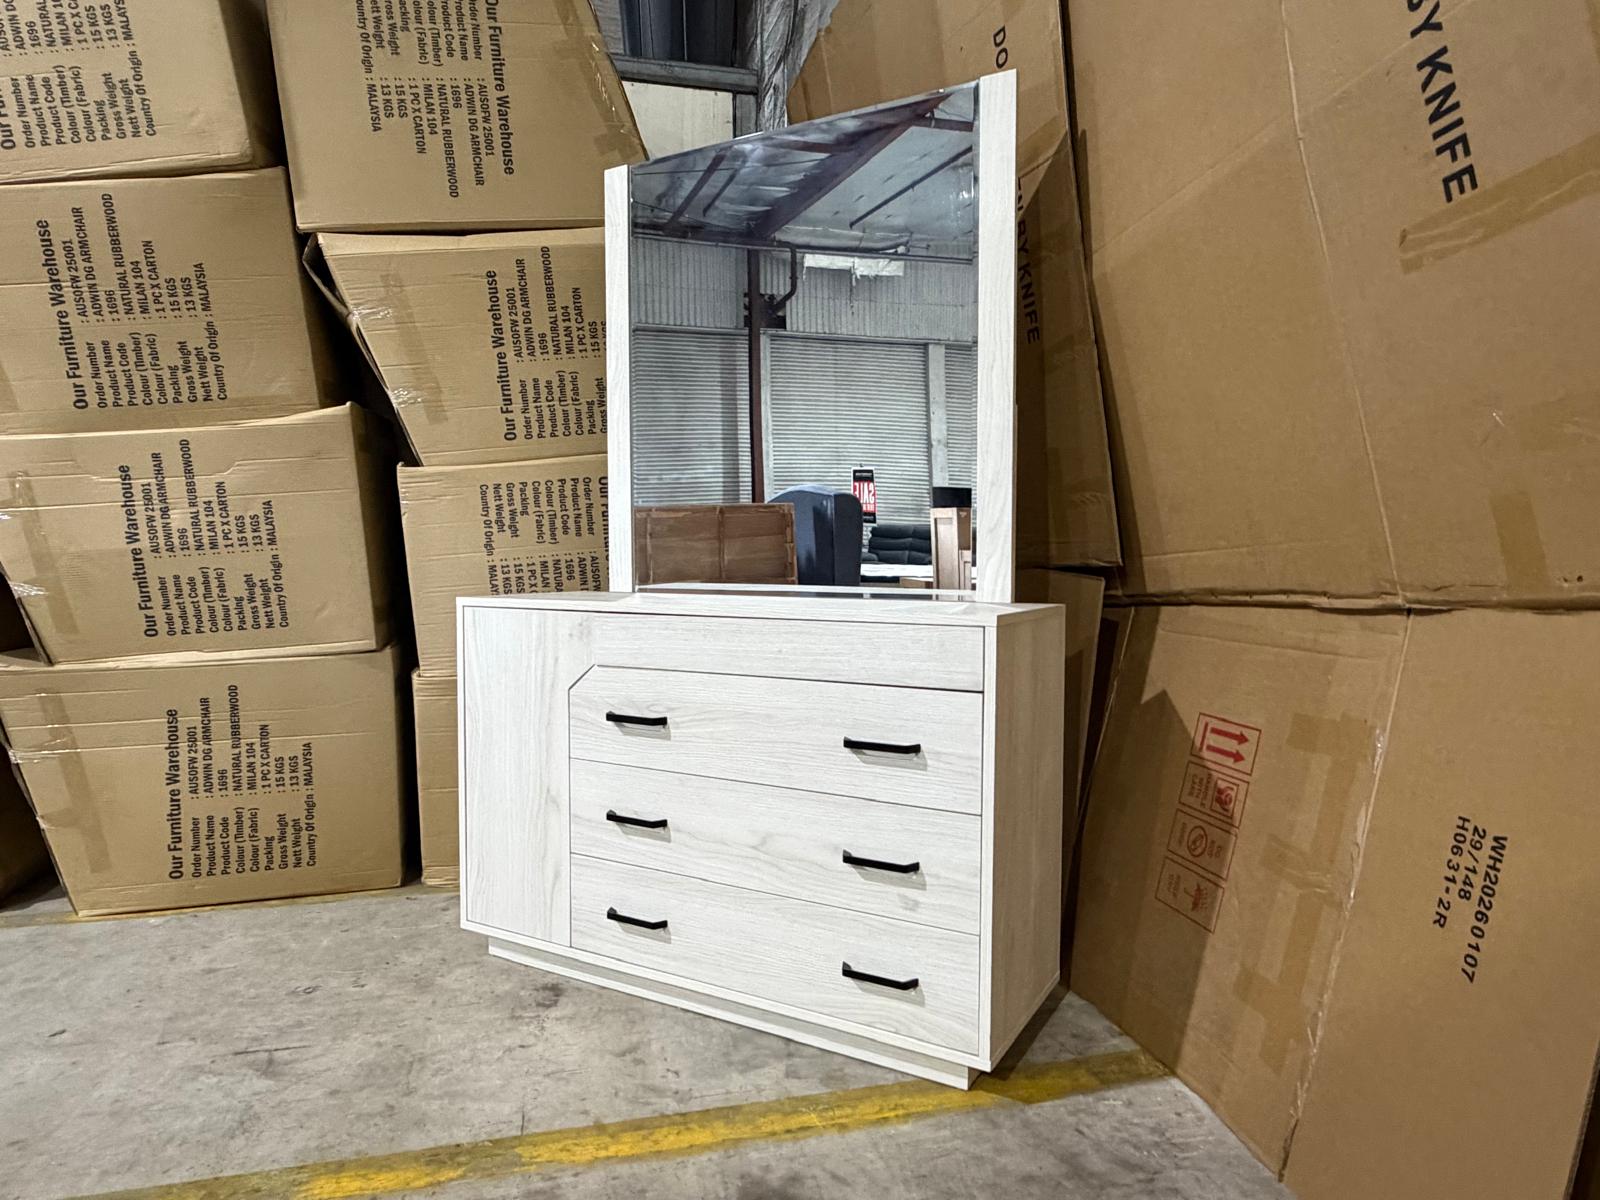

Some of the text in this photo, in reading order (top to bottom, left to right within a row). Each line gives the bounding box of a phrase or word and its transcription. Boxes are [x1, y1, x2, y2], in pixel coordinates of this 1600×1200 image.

[25, 21, 41, 47] 1696
[488, 26, 505, 91] Furniture
[993, 25, 1008, 69] DO
[10, 77, 35, 148] Order Number
[25, 74, 51, 146] Product Name
[40, 76, 67, 145] Product Code
[52, 65, 81, 143] Colour (Timber)
[68, 66, 96, 142] Colour (Fabric)
[93, 100, 112, 140] Packing
[128, 50, 156, 136] Country Of Origin
[366, 84, 381, 132] MALAYSIA
[423, 84, 438, 134] MILAN 104
[450, 85, 462, 108] 1696
[1416, 45, 1478, 203] KNIFE
[0, 122, 16, 150] Our
[437, 83, 459, 198] NATURAL RUBBERWOOD
[464, 83, 484, 185] ADWIN DG ARMCHAIR
[482, 126, 494, 156] 25001
[496, 95, 514, 175] Warehouse
[61, 239, 78, 272] 25001
[71, 207, 104, 316] ADWIN DG ARMCHAIR
[101, 193, 134, 315] NATURAL RUBBERWOOD
[36, 220, 88, 409] Our Furniture Warehouse
[104, 290, 119, 315] 1696
[129, 260, 150, 314] MILAN 104
[164, 277, 181, 312] 15 KGS
[193, 262, 211, 311] MALAYSIA
[505, 287, 518, 316] 25001
[515, 258, 536, 357] ADWIN DG ARMCHAIR
[540, 246, 562, 355] NATURAL RUBBERWOOD
[1018, 262, 1040, 344] KNIFE
[101, 340, 123, 407] Product Name
[116, 342, 138, 406] Product Code
[128, 332, 153, 405] Colour (Timber)
[144, 333, 168, 404] Colour (Fabric)
[204, 321, 227, 400] Country Of Origin
[486, 270, 517, 441] Our Furniture Warehouse
[538, 332, 549, 355] 1696
[86, 342, 107, 408] Order Number
[167, 365, 183, 403] Packing
[555, 370, 571, 436] Colour (Timber)
[518, 379, 533, 440] Order Number
[532, 378, 546, 438] Product Name
[140, 482, 155, 512] 25001
[151, 452, 175, 553] ADWIN DG ARMCHAIR
[179, 439, 205, 550] NATURAL RUBBERWOOD
[202, 500, 219, 549] MILAN 104
[262, 500, 277, 545] MALAYSIA
[479, 484, 495, 556] Country Of Origin
[493, 483, 506, 533] Nett Weight
[519, 481, 529, 516] Packing
[544, 479, 559, 544] Colour (Timber)
[557, 478, 570, 535] Product Code
[570, 477, 582, 536] Product Name
[582, 477, 595, 535] Order Number
[118, 465, 158, 637] Our Furniture Warehouse
[177, 528, 190, 551] 1696
[565, 558, 575, 581] 1696
[172, 574, 191, 635] Product Name
[186, 576, 205, 634] Product Code
[198, 566, 219, 633] Colour (Timber)
[539, 560, 550, 588] MILAN
[158, 576, 176, 636] Order Number
[233, 596, 247, 630] Packing
[186, 726, 198, 754] 25001
[199, 697, 213, 793] ADWIN DG ARMCHAIR
[228, 685, 242, 791] NATURAL RUBBERWOOD
[245, 742, 256, 790] MILAN 104
[302, 742, 313, 786] MALAYSIA
[164, 709, 183, 879] Our Furniture Warehouse
[217, 769, 228, 791] 1696
[190, 817, 201, 877] Order Number
[205, 815, 216, 876] Product Name
[233, 807, 246, 873] Colour (Timber)
[247, 807, 260, 872] Colour (Fabric)
[1457, 825, 1487, 901] 29/148
[1432, 815, 1470, 929] H0631-2R
[1461, 835, 1508, 984] WH20260107
